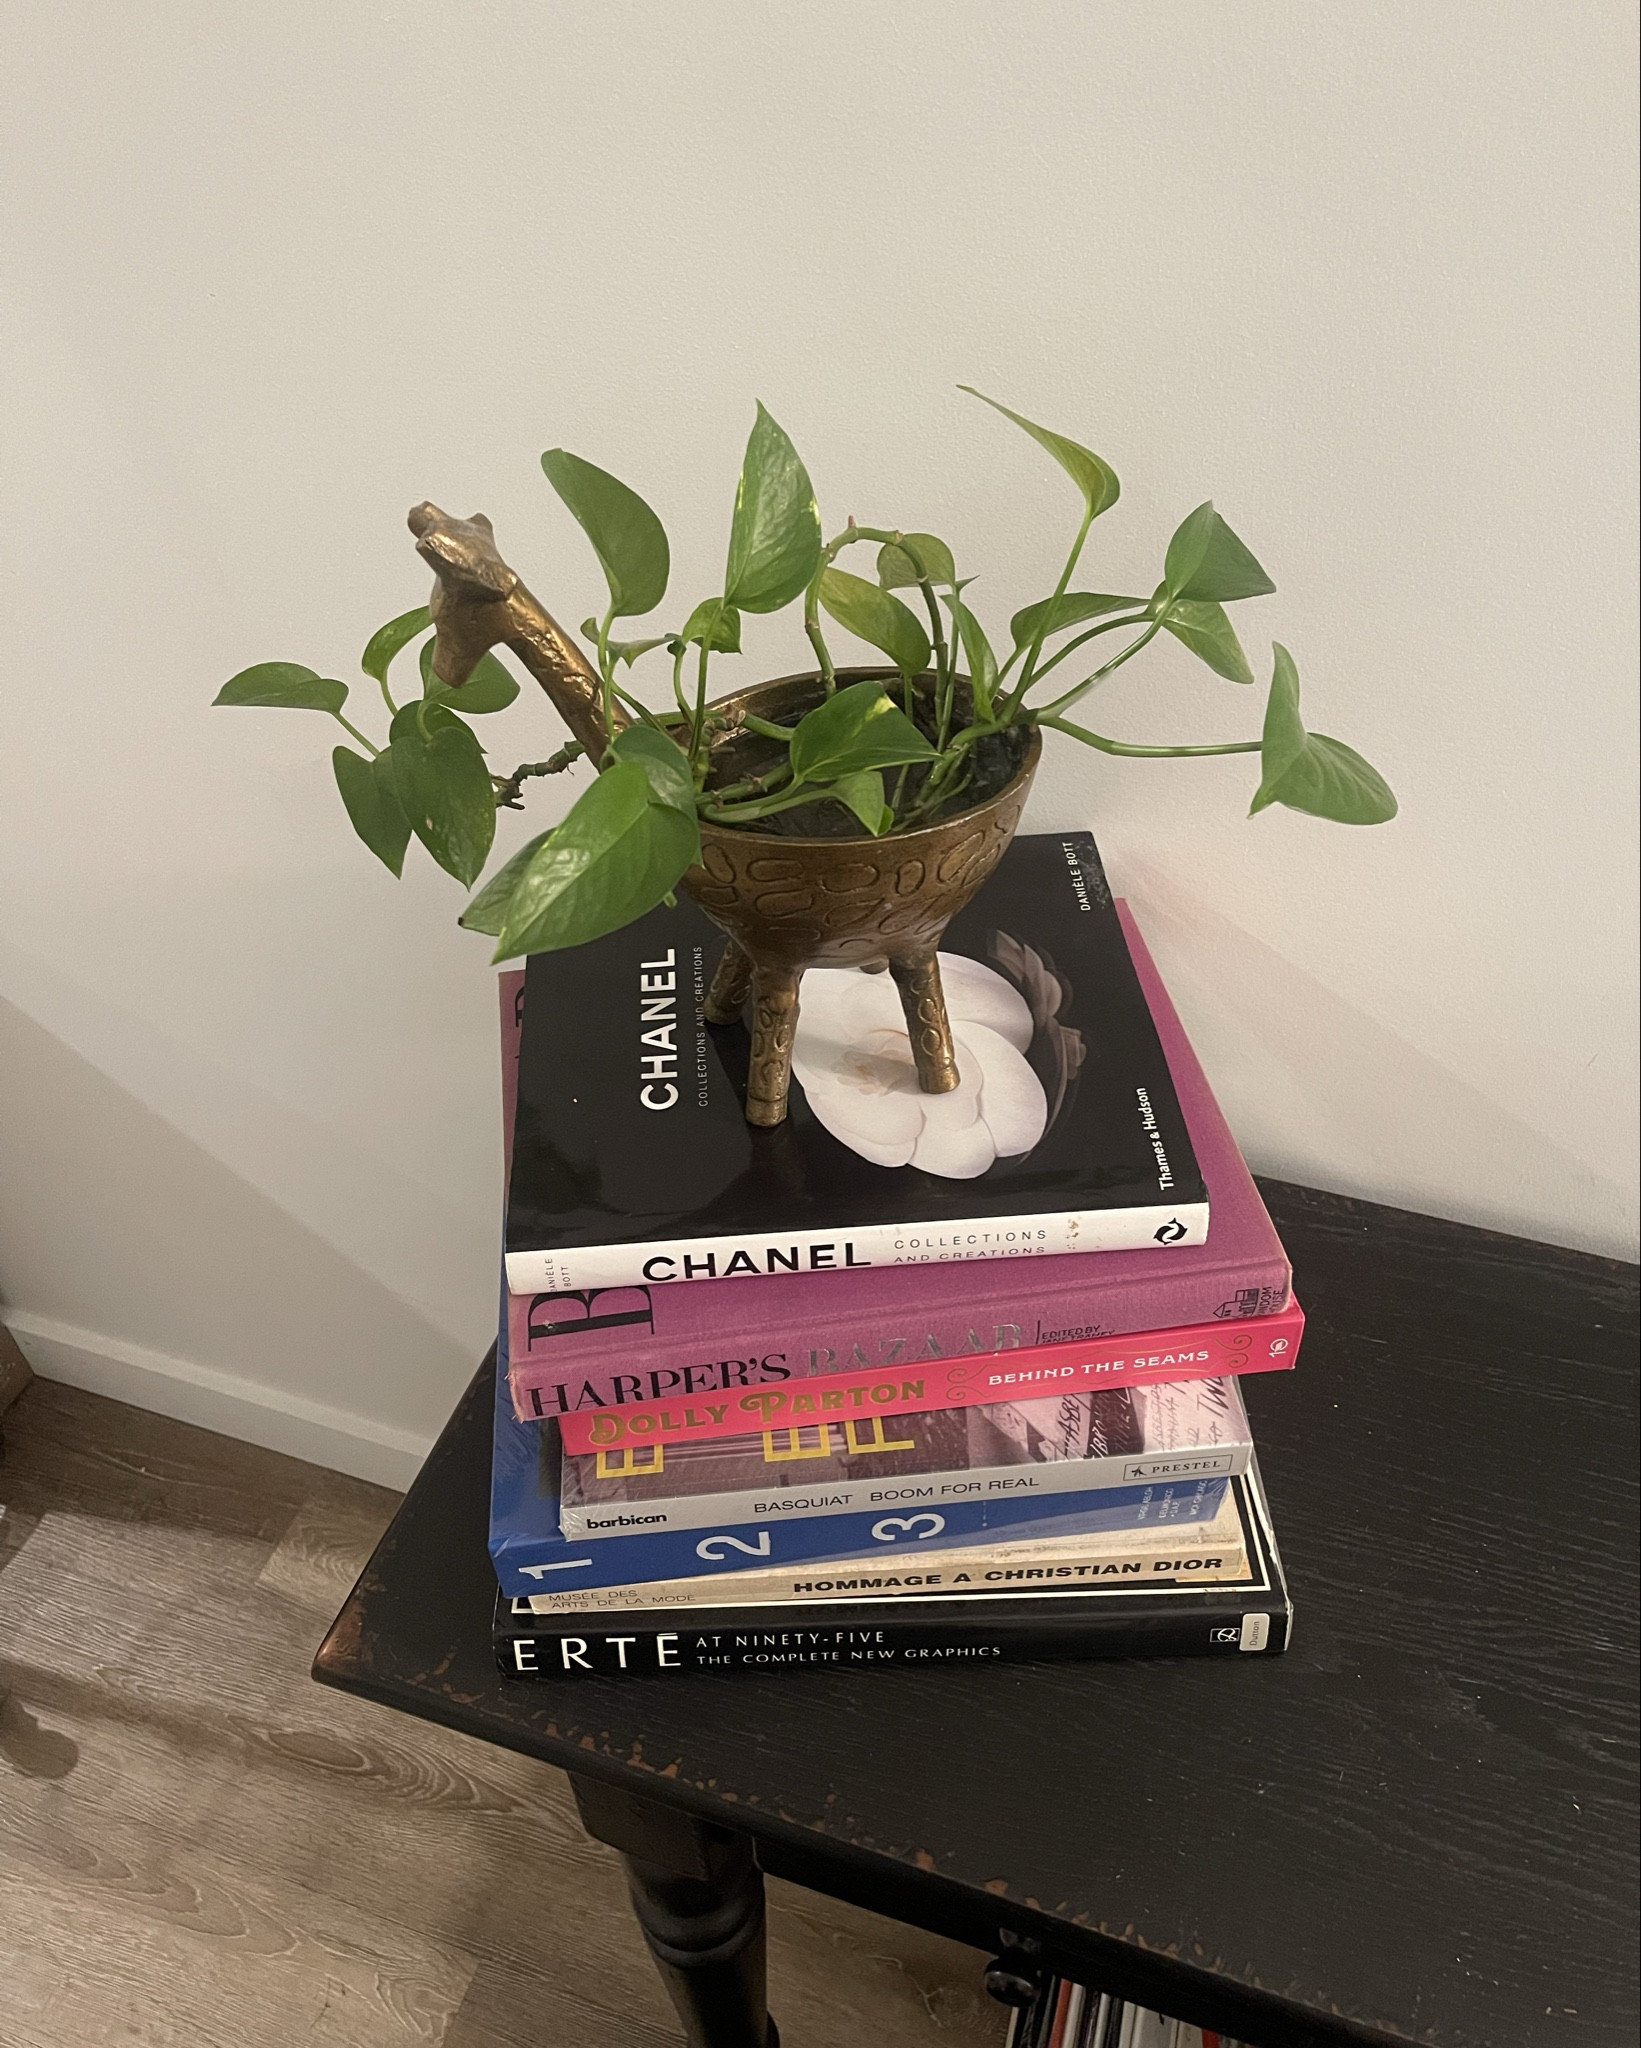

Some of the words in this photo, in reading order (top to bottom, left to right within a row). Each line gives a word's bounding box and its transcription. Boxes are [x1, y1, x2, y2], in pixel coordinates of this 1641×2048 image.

[1062, 841, 1077, 866] BOTT
[693, 946, 703, 1002] CREATIONS
[640, 948, 679, 1111] CHANEL
[696, 1006, 705, 1028] AND
[696, 1032, 708, 1107] COLLECTIONS
[1136, 1087, 1157, 1130] Hudson
[1150, 1126, 1160, 1140] &
[1150, 1140, 1174, 1191] Thames
[894, 1230, 1046, 1250] COLLECTIONS
[642, 1241, 872, 1282] CHANEL
[894, 1254, 931, 1264] AND
[939, 1246, 1046, 1261] CREATIONS
[561, 1266, 571, 1287] BOTT
[1042, 1327, 1083, 1340] EDITED
[1085, 1325, 1101, 1334] BY
[988, 1366, 1075, 1387] BEHIND
[1081, 1361, 1124, 1375] THE
[1133, 1350, 1210, 1368] SEAMS
[525, 1353, 792, 1417] HARPER'S
[588, 1404, 729, 1446] DOLLY
[739, 1380, 926, 1424] PARTON
[1152, 1459, 1222, 1474] PRESTEL
[754, 1494, 853, 1513] BASQUIAT
[870, 1487, 934, 1502] BOOM
[941, 1482, 982, 1495] FOR
[988, 1477, 1040, 1490] REAL
[586, 1512, 667, 1530] barbican
[871, 1512, 946, 1541] 3
[696, 1530, 772, 1561] 2
[518, 1558, 593, 1580] 1
[793, 1575, 941, 1593] HOMMAGE
[953, 1573, 972, 1584] A
[984, 1562, 1141, 1581] CHRISTIAN
[1153, 1557, 1223, 1572] DIOR
[548, 1591, 599, 1602] MUSÉE
[608, 1589, 638, 1598] DES
[551, 1600, 589, 1609] ARTS
[597, 1599, 617, 1607] DE
[625, 1597, 644, 1605] LA
[652, 1594, 696, 1603] MODE
[696, 1636, 722, 1649] AT
[736, 1631, 885, 1647] NINETY-FIVE
[1249, 1621, 1260, 1646] Dutton
[697, 1654, 731, 1665] THE
[743, 1651, 840, 1664] COMPLETE
[851, 1649, 895, 1660] NEW
[904, 1647, 1001, 1658] GRAPHICS
